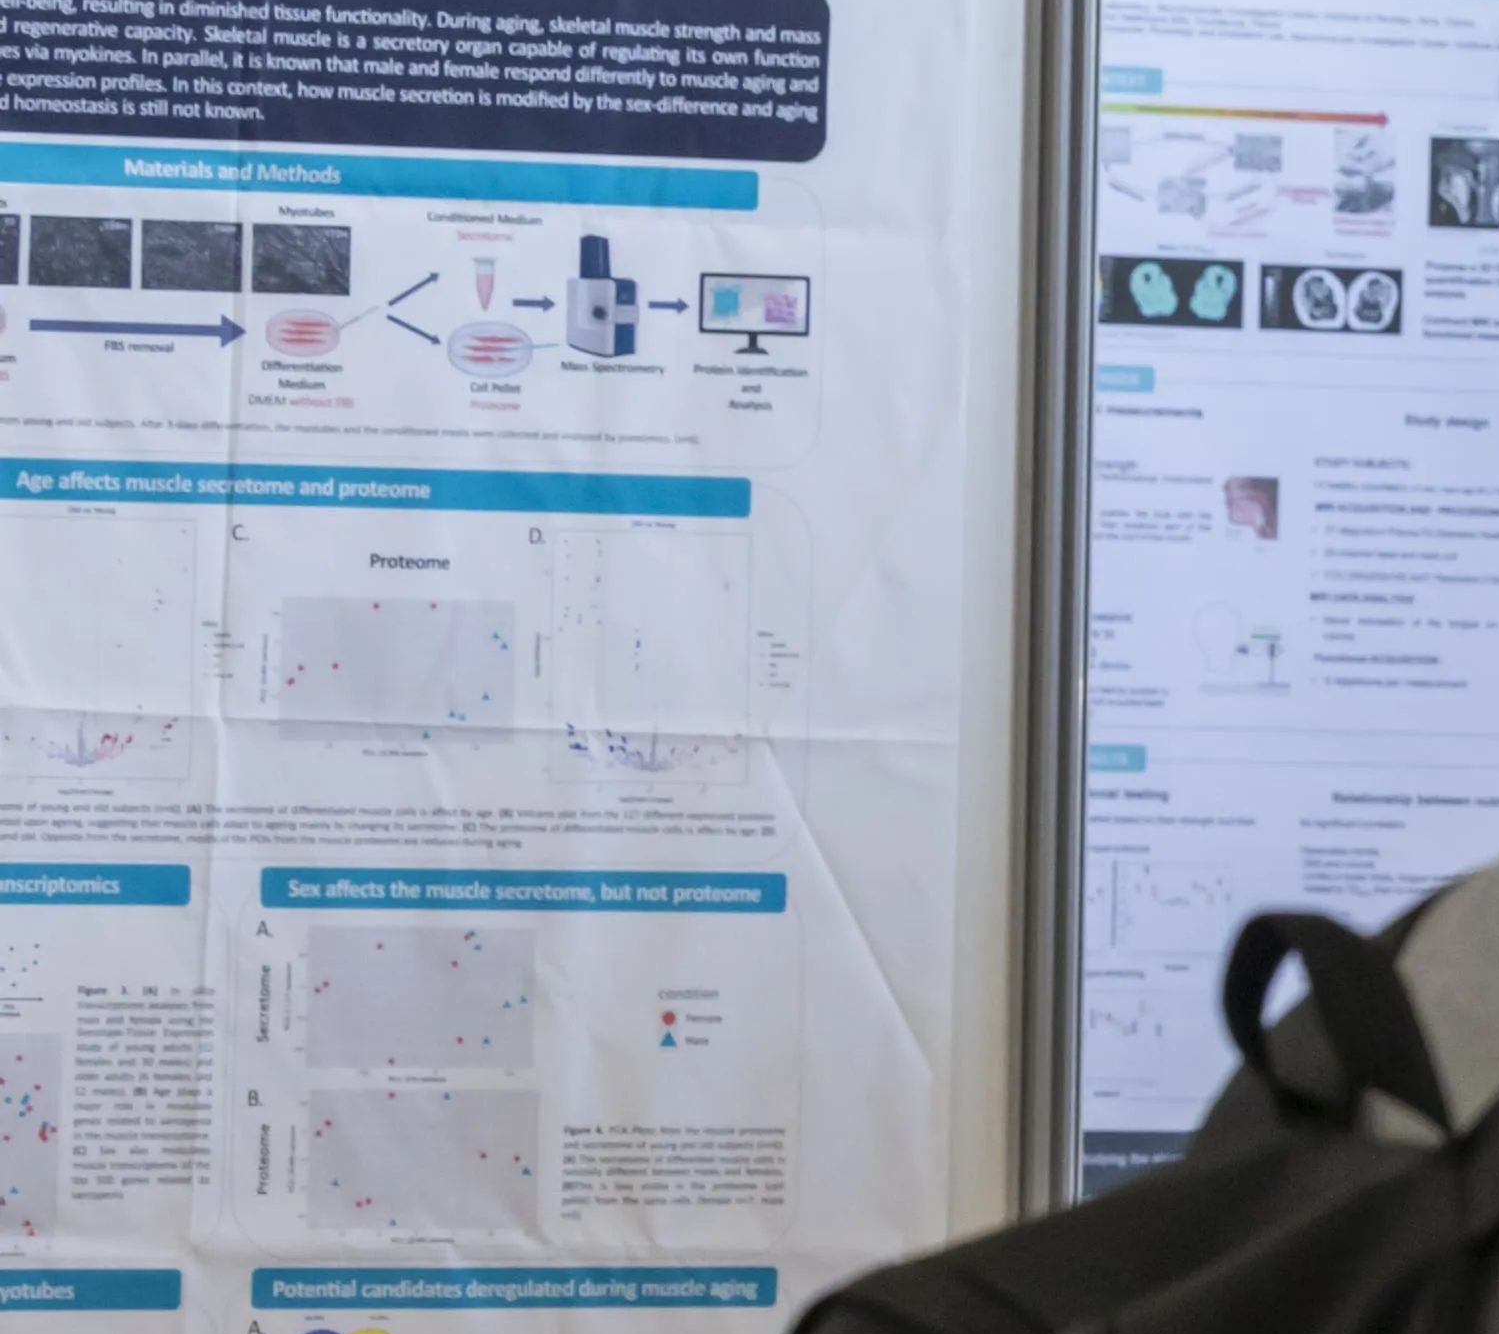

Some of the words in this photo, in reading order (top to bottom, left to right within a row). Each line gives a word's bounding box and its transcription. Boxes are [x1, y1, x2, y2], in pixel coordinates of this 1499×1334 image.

[178, 0, 271, 20] diminished
[273, 4, 322, 23] tissue
[324, 4, 432, 32] functionality.
[436, 10, 492, 34] During
[495, 15, 545, 37] aging,
[548, 16, 612, 35] skeletal
[614, 20, 671, 39] muscle
[673, 23, 742, 45] strength
[779, 29, 822, 45] mass
[13, 20, 119, 39] regenerative
[123, 24, 197, 45] capacity.
[203, 24, 268, 45] Skeletal
[272, 29, 332, 48] muscle
[372, 36, 451, 55] secretory
[454, 39, 503, 59] organ
[507, 39, 574, 60] capable
[601, 43, 681, 67] regulating
[711, 50, 749, 65] own
[753, 48, 821, 69] function
[53, 44, 137, 65] myokines.
[162, 49, 229, 69] parallel,
[265, 52, 322, 72] known
[363, 57, 405, 76] male
[442, 59, 501, 80] female
[503, 64, 572, 84] respond
[574, 65, 657, 89] differently
[680, 71, 740, 90] muscle
[741, 74, 787, 96] aging
[6, 71, 97, 90] expression
[100, 73, 168, 94] profiles.
[226, 80, 294, 99] context,
[337, 83, 396, 103] muscle
[399, 88, 475, 105] secretion
[495, 89, 570, 109] modified
[625, 96, 739, 116] sex-difference
[775, 101, 819, 123] aging
[13, 93, 119, 115] homeostasis
[138, 99, 169, 116] still
[204, 100, 265, 120] known.
[123, 158, 214, 179] Materials
[216, 162, 254, 182] and
[256, 163, 341, 184] Methods
[15, 470, 55, 494] Age
[57, 470, 122, 492] affects
[124, 473, 193, 493] muscle
[196, 477, 296, 495] secretome
[298, 477, 335, 496] and
[338, 480, 432, 501] proteome
[370, 553, 451, 572] Proteome
[287, 879, 322, 898] Sex
[324, 879, 386, 899] affects
[389, 880, 422, 899] the
[425, 881, 492, 900] muscle
[495, 884, 597, 903] secretome,
[600, 882, 633, 901] but
[636, 884, 669, 902] not
[672, 885, 762, 905] proteome
[272, 1279, 358, 1299] Potential
[360, 1279, 464, 1299] candidates
[464, 1278, 576, 1302] deregulated
[577, 1278, 638, 1301] during
[641, 1278, 707, 1297] muscle
[709, 1279, 759, 1301] aging
